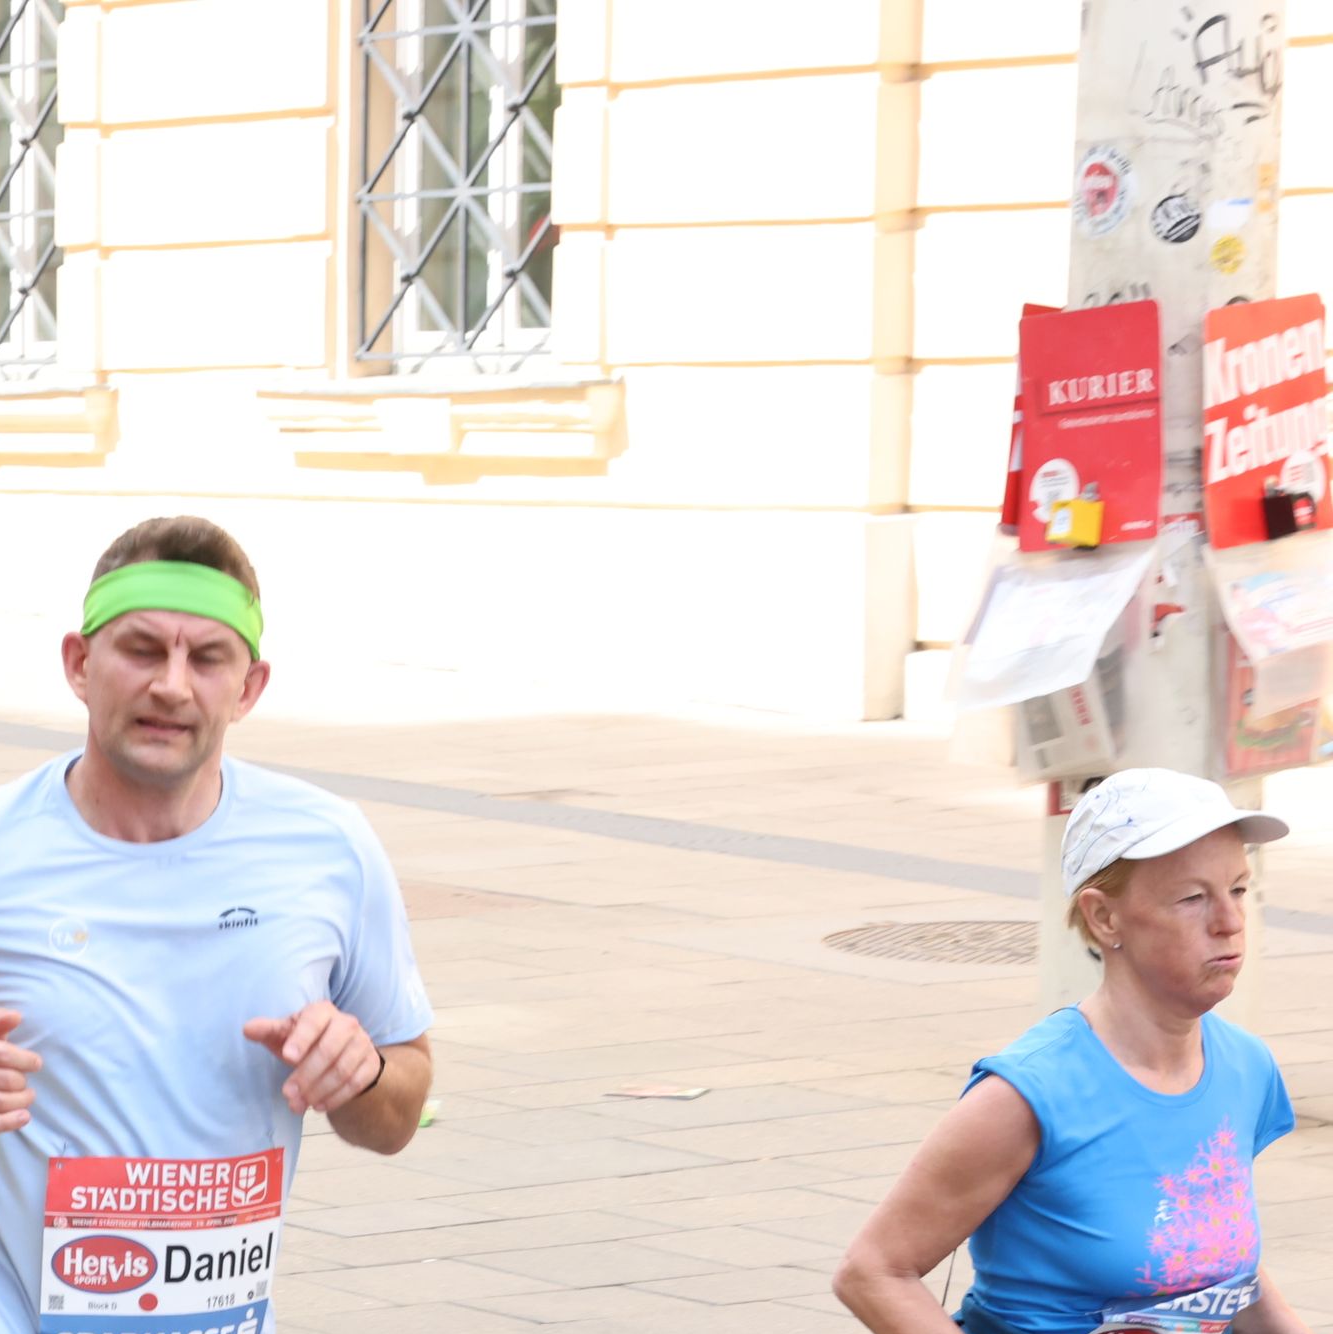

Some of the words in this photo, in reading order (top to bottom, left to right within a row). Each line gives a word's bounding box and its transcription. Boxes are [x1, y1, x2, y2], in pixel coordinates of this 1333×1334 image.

[1203, 318, 1325, 410] Kronen
[1048, 368, 1155, 406] KURIER
[218, 917, 258, 930] skinfit
[125, 1162, 231, 1187] WIENER
[71, 1186, 229, 1213] STÄDTISCHE
[63, 1246, 149, 1283] Hervis
[164, 1232, 274, 1284] Daniel
[73, 1275, 107, 1286] SPORTS
[88, 1301, 108, 1311] Block
[206, 1294, 235, 1309] 17618
